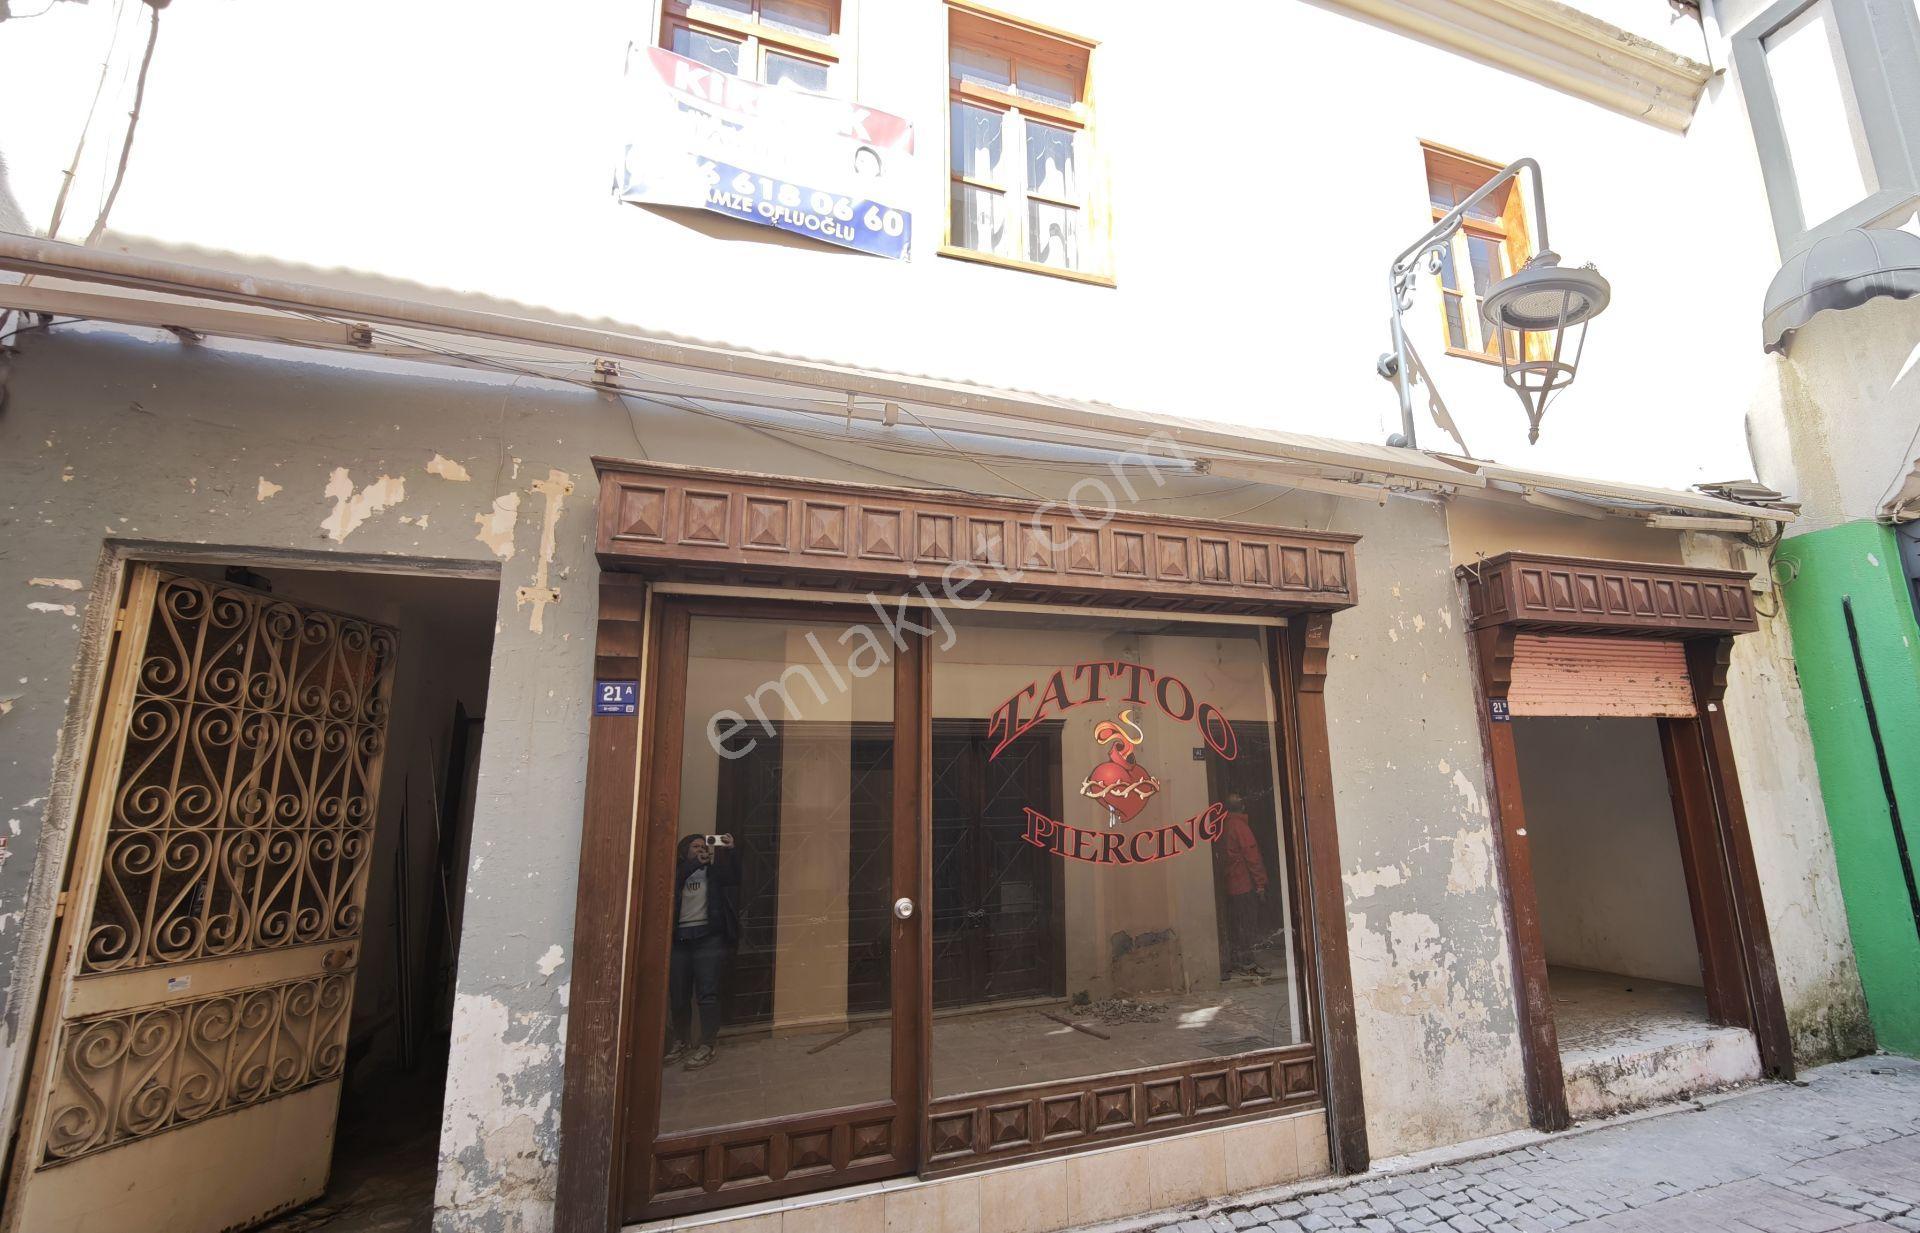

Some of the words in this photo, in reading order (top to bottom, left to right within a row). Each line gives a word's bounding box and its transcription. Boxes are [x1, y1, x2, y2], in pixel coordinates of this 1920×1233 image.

[732, 172, 801, 207] 618
[810, 191, 854, 221] 06
[864, 205, 904, 237] 60
[603, 685, 622, 702] 21
[625, 686, 633, 695] A
[988, 661, 1237, 762] TATTOO
[1492, 702, 1503, 713] 21
[1021, 802, 1228, 865] PIERCING
